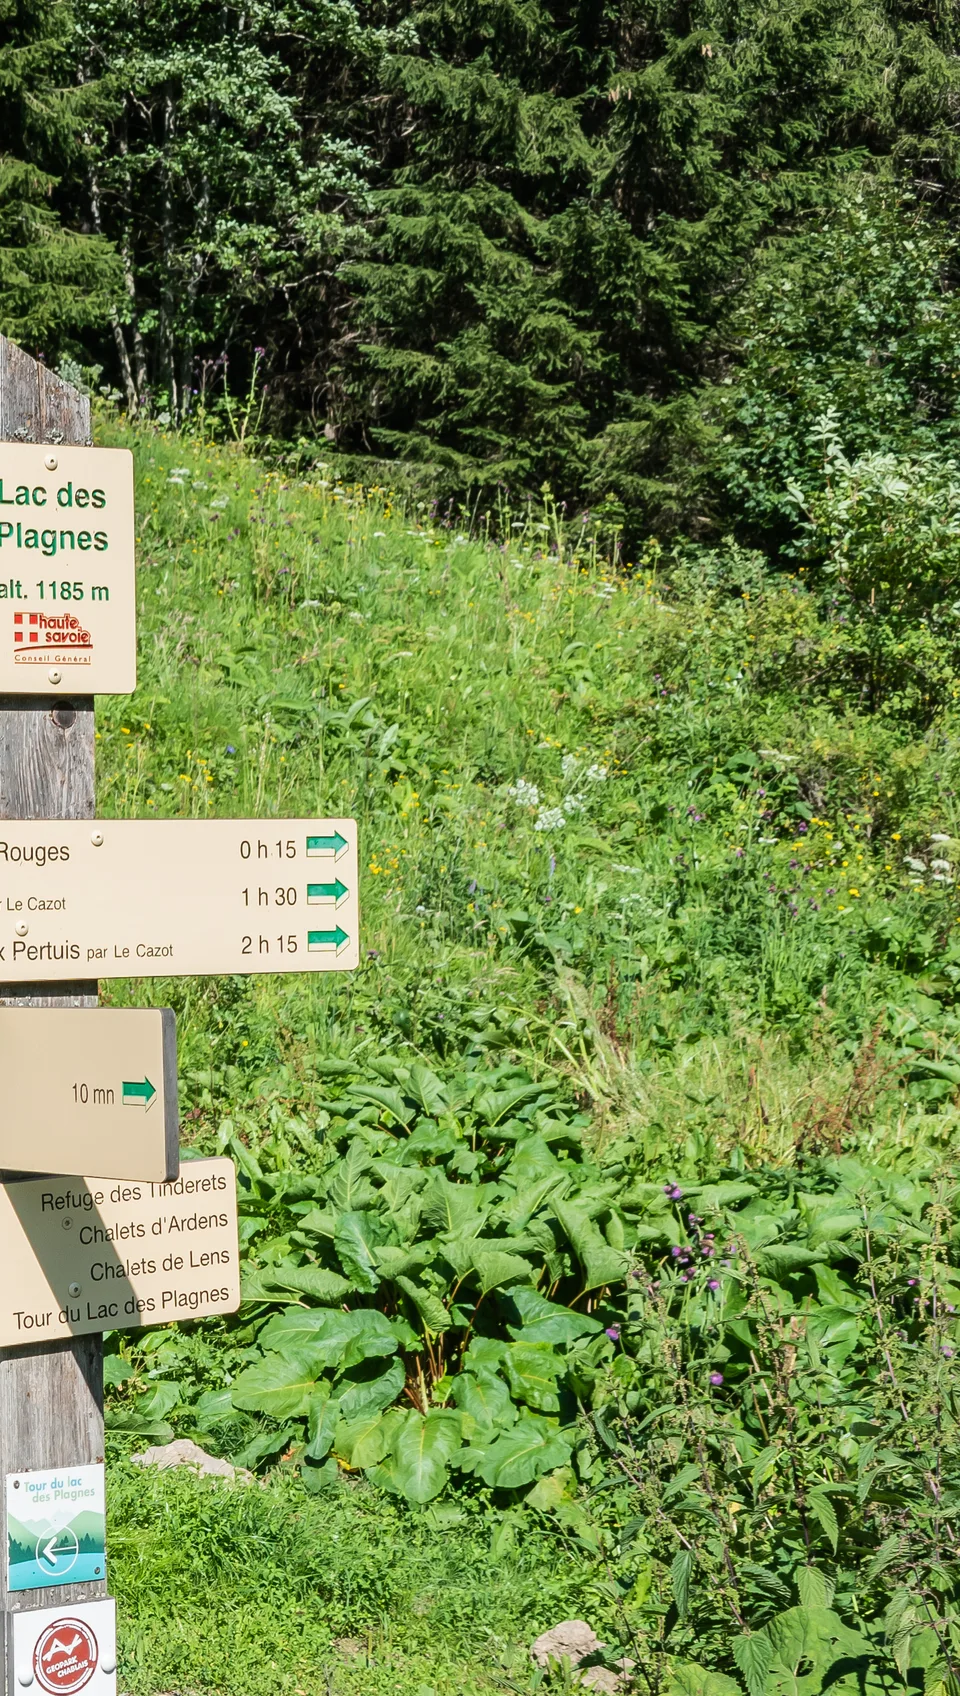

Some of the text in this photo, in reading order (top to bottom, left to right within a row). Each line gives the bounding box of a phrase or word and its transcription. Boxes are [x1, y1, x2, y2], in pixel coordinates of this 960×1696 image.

[57, 481, 107, 509] des
[36, 580, 84, 601] 1185
[91, 585, 109, 601] m
[39, 614, 78, 629] haute
[45, 628, 89, 643] savoie
[14, 654, 91, 663] Conseil Général
[240, 840, 297, 859] 0 h 15
[6, 897, 23, 911] Le
[27, 896, 66, 911] Cazot
[241, 887, 297, 906] 1 h 30
[12, 940, 80, 961] Pertuis
[87, 945, 108, 962] par
[114, 944, 130, 959] Le
[136, 943, 174, 958] Cazot
[241, 935, 298, 955] 2 h 15
[72, 1083, 115, 1105] 10 mn
[41, 1174, 227, 1212] Refuge des Tinderets
[79, 1213, 228, 1245] Chalets d'Ardens
[90, 1249, 230, 1282] Chalets de Lens
[13, 1286, 230, 1330] Tour du Lac des Plagnes
[24, 1475, 82, 1492] Tour du lac
[32, 1488, 95, 1503] des Plagnes
[45, 1655, 79, 1675] GEOPARK
[57, 1659, 88, 1678] CHABLAIS
